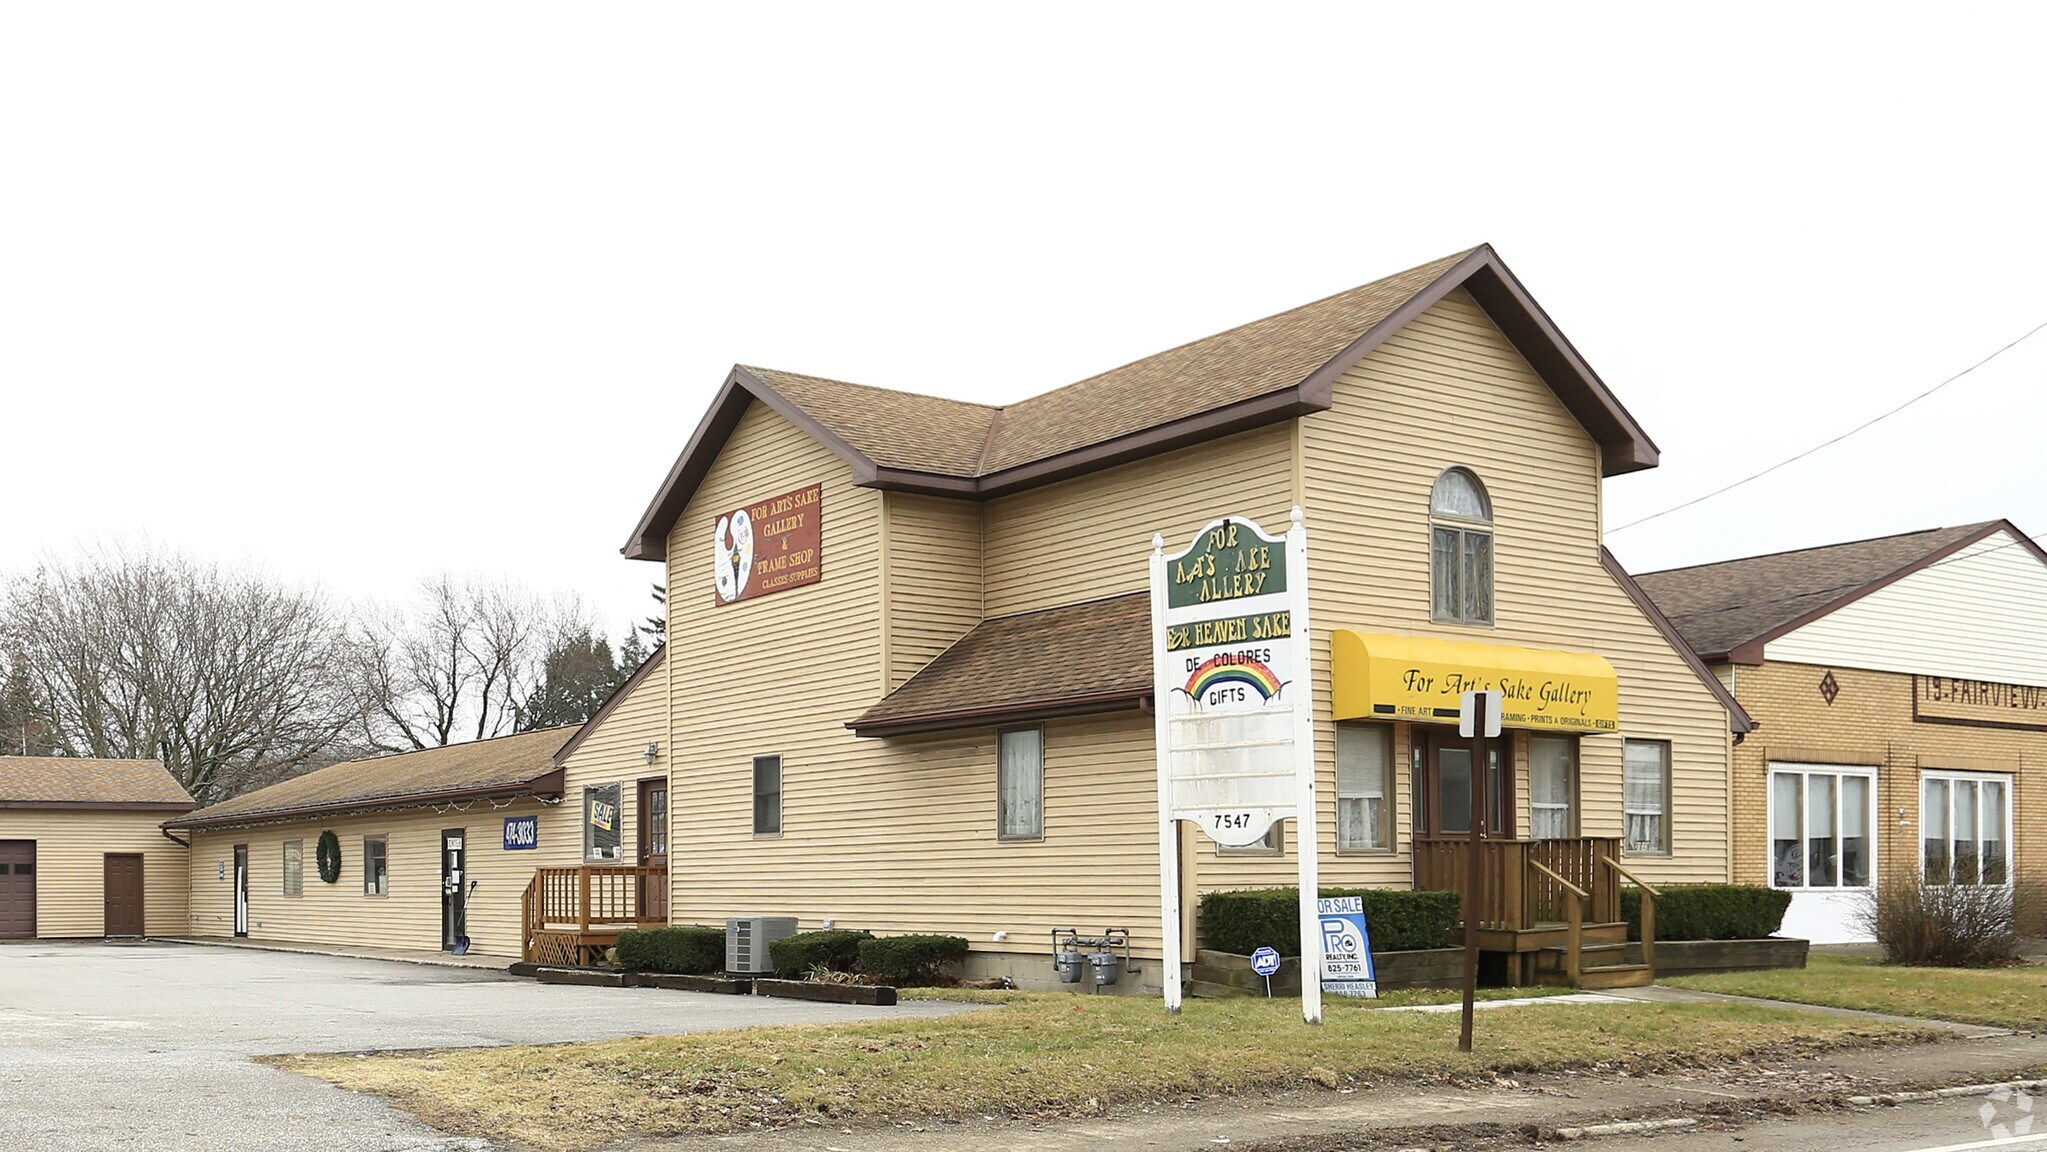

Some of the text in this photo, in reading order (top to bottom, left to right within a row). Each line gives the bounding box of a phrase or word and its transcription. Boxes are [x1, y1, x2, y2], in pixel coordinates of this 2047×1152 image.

[751, 489, 819, 522] FOR ART'S SAKE
[763, 513, 805, 537] GALLERY
[781, 538, 788, 551] &
[1206, 525, 1238, 552] FOR
[757, 548, 814, 575] FRAME SHOP
[1195, 618, 1247, 645] HEAVEN
[1252, 612, 1290, 639] SAKE
[1186, 648, 1271, 673] DE COLORES
[1209, 687, 1246, 706] GIFTS
[1403, 669, 1434, 693] For
[1500, 678, 1533, 701] Sake
[1537, 680, 1592, 716] Gallery
[1951, 678, 2040, 709] FAIRVIEW
[1401, 706, 1416, 715] FINE
[1418, 707, 1432, 716] ART
[1501, 712, 1526, 722] RAMING
[1531, 714, 1552, 724] PRINTS
[1560, 717, 1591, 727] ORIGINALS
[1214, 814, 1250, 829] 7547
[1317, 898, 1362, 914] OR SALE
[1321, 920, 1357, 953] PRO
[1256, 956, 1275, 968] ADT
[1327, 964, 1361, 972] 825-7761
